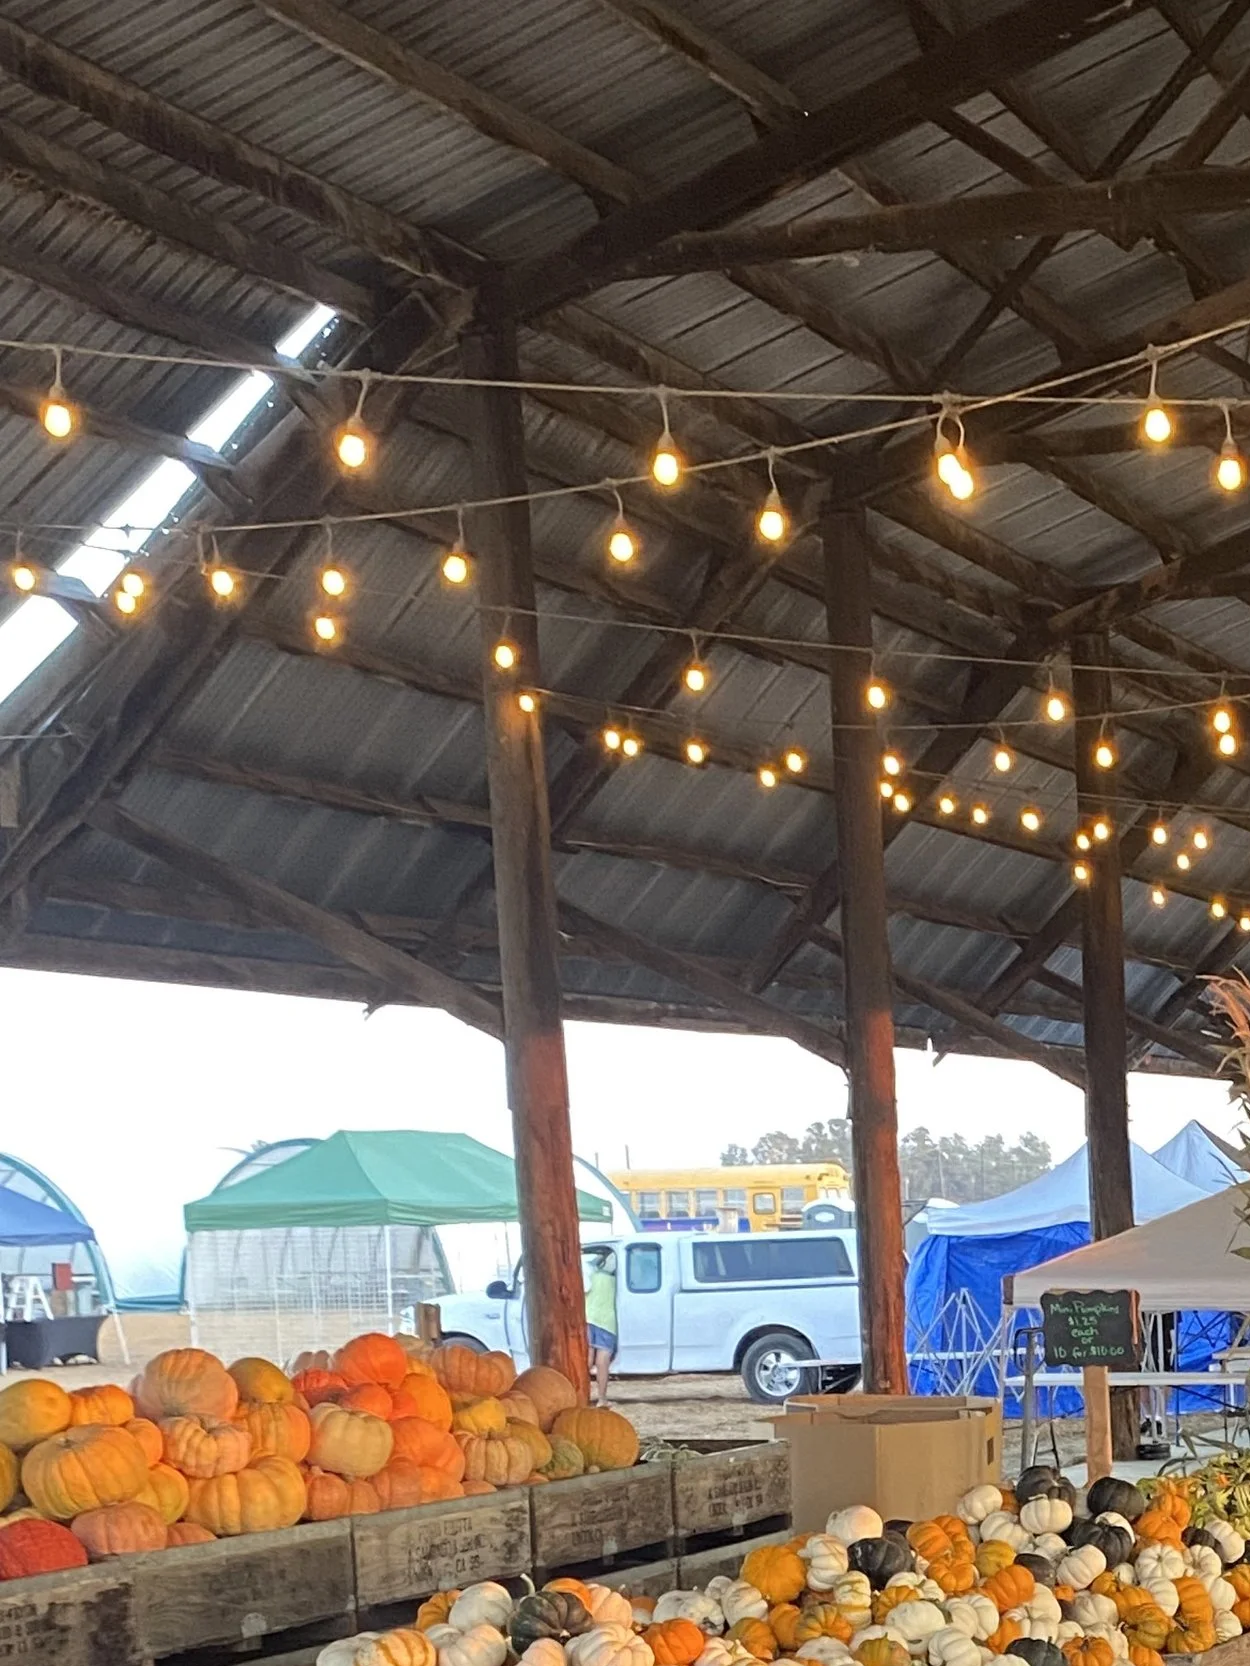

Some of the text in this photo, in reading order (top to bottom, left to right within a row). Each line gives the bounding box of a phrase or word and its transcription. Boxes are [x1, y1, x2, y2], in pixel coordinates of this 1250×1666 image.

[1072, 1300, 1120, 1317] Pumpkins
[1070, 1326, 1099, 1338] each
[1081, 1336, 1094, 1344] or
[1052, 1346, 1067, 1359] 10
[1072, 1346, 1087, 1359] for
